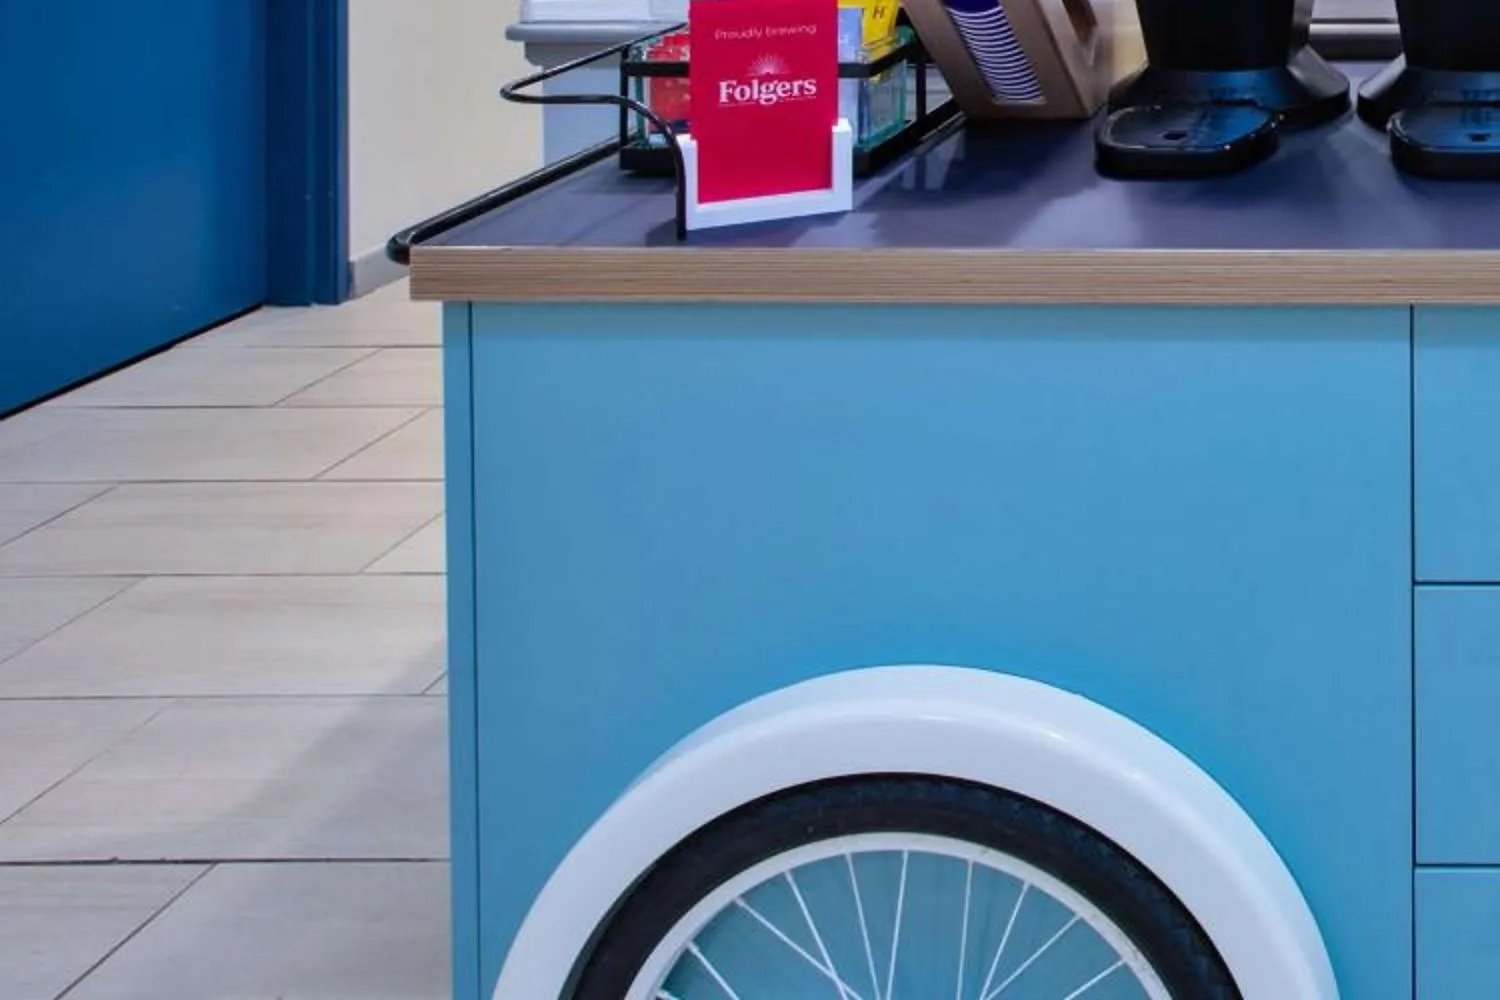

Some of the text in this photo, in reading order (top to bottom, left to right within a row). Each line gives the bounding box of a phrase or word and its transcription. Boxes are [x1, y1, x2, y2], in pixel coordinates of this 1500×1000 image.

[714, 24, 818, 41] Proudly brewing
[719, 77, 817, 106] Folgers
